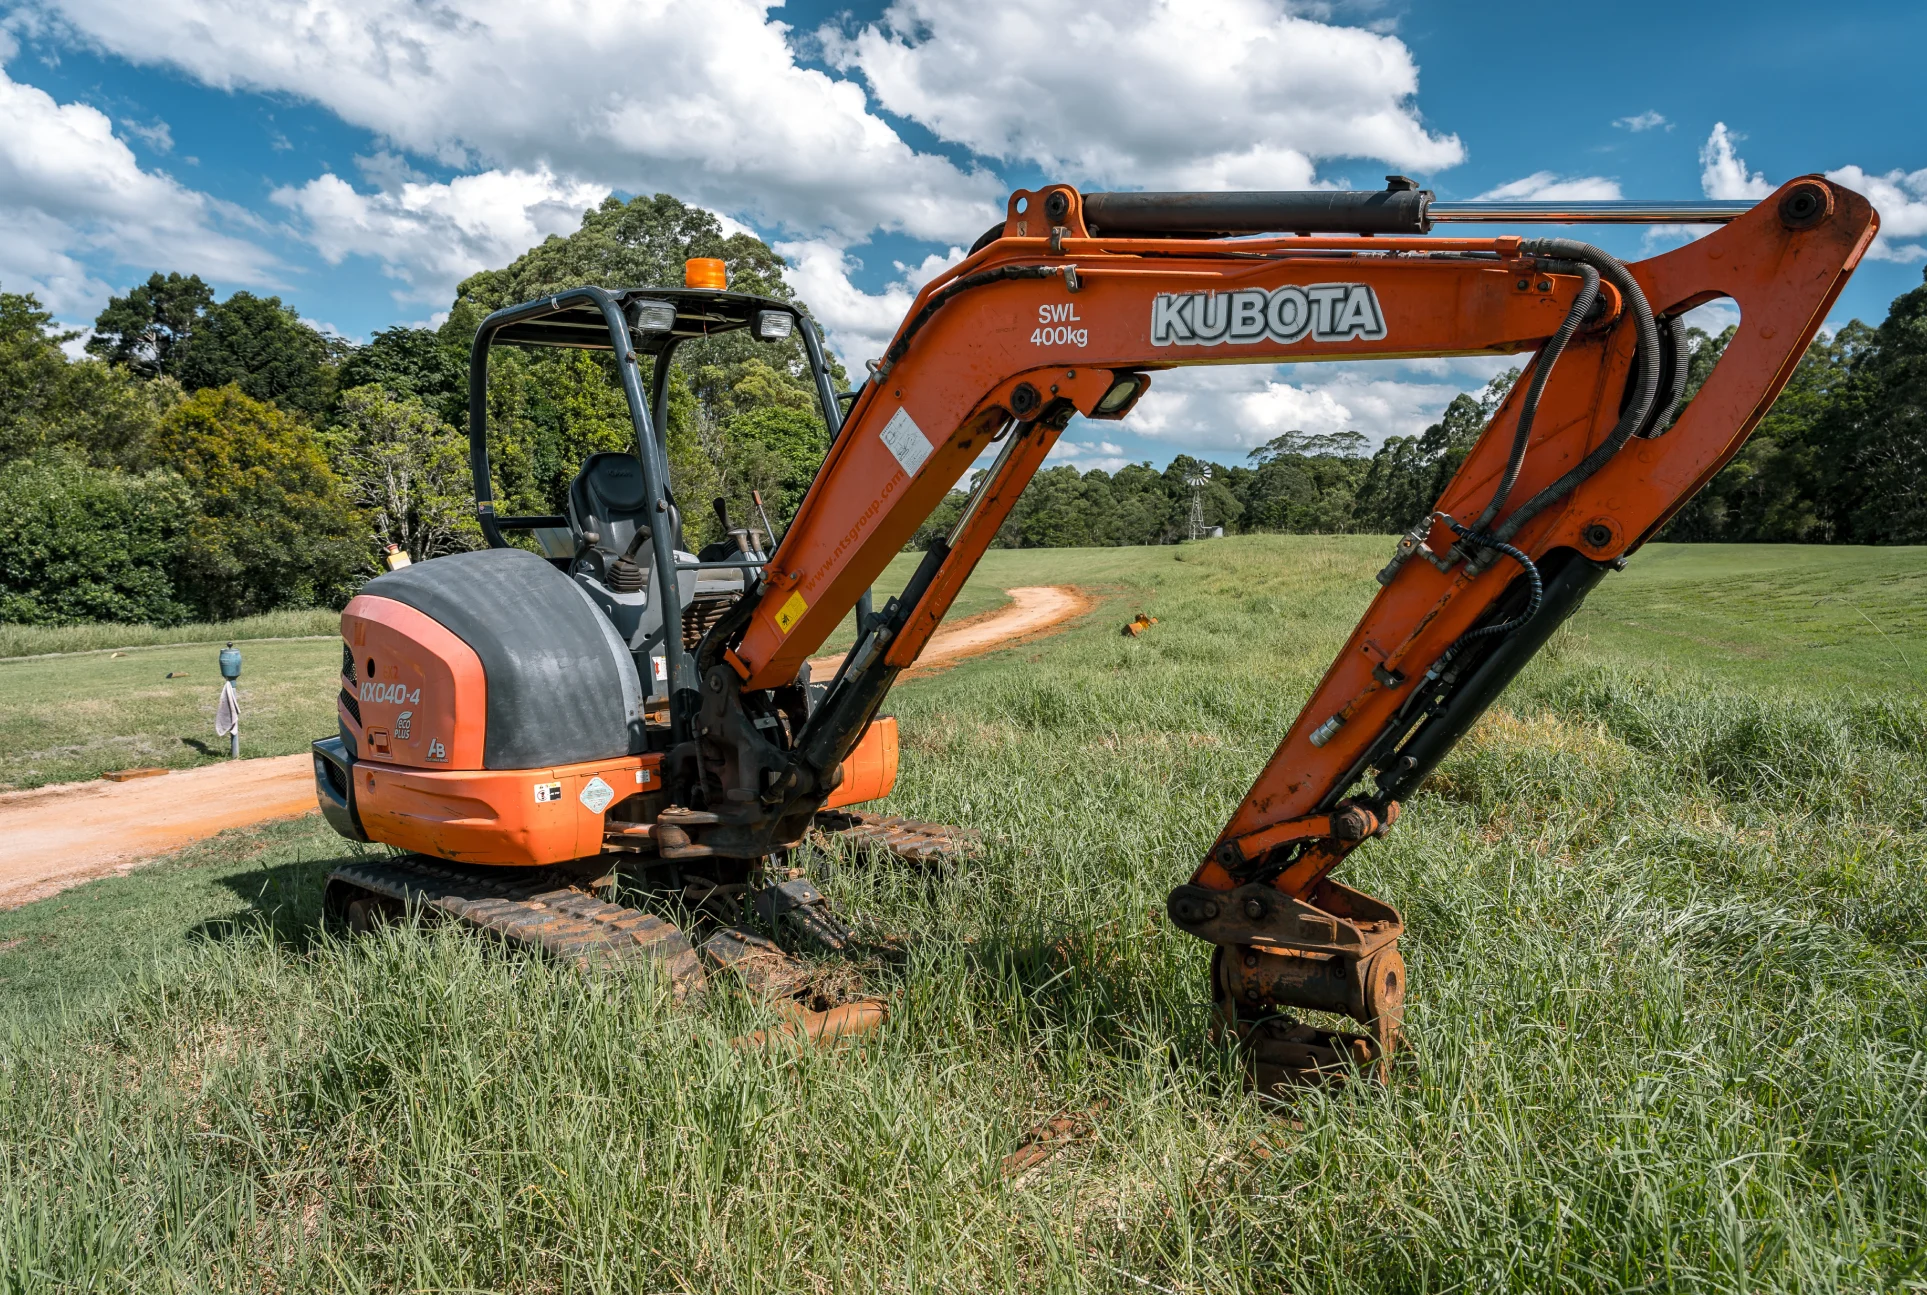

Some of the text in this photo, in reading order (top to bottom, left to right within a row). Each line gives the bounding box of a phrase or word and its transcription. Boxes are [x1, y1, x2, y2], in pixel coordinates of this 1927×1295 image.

[1038, 302, 1081, 324] SWL
[1154, 285, 1381, 341] KUBOTA
[1030, 326, 1088, 348] 400kg
[804, 468, 906, 593] www.ntsgroup.com
[359, 681, 421, 706] KX040-4
[394, 729, 410, 740] PLUS
